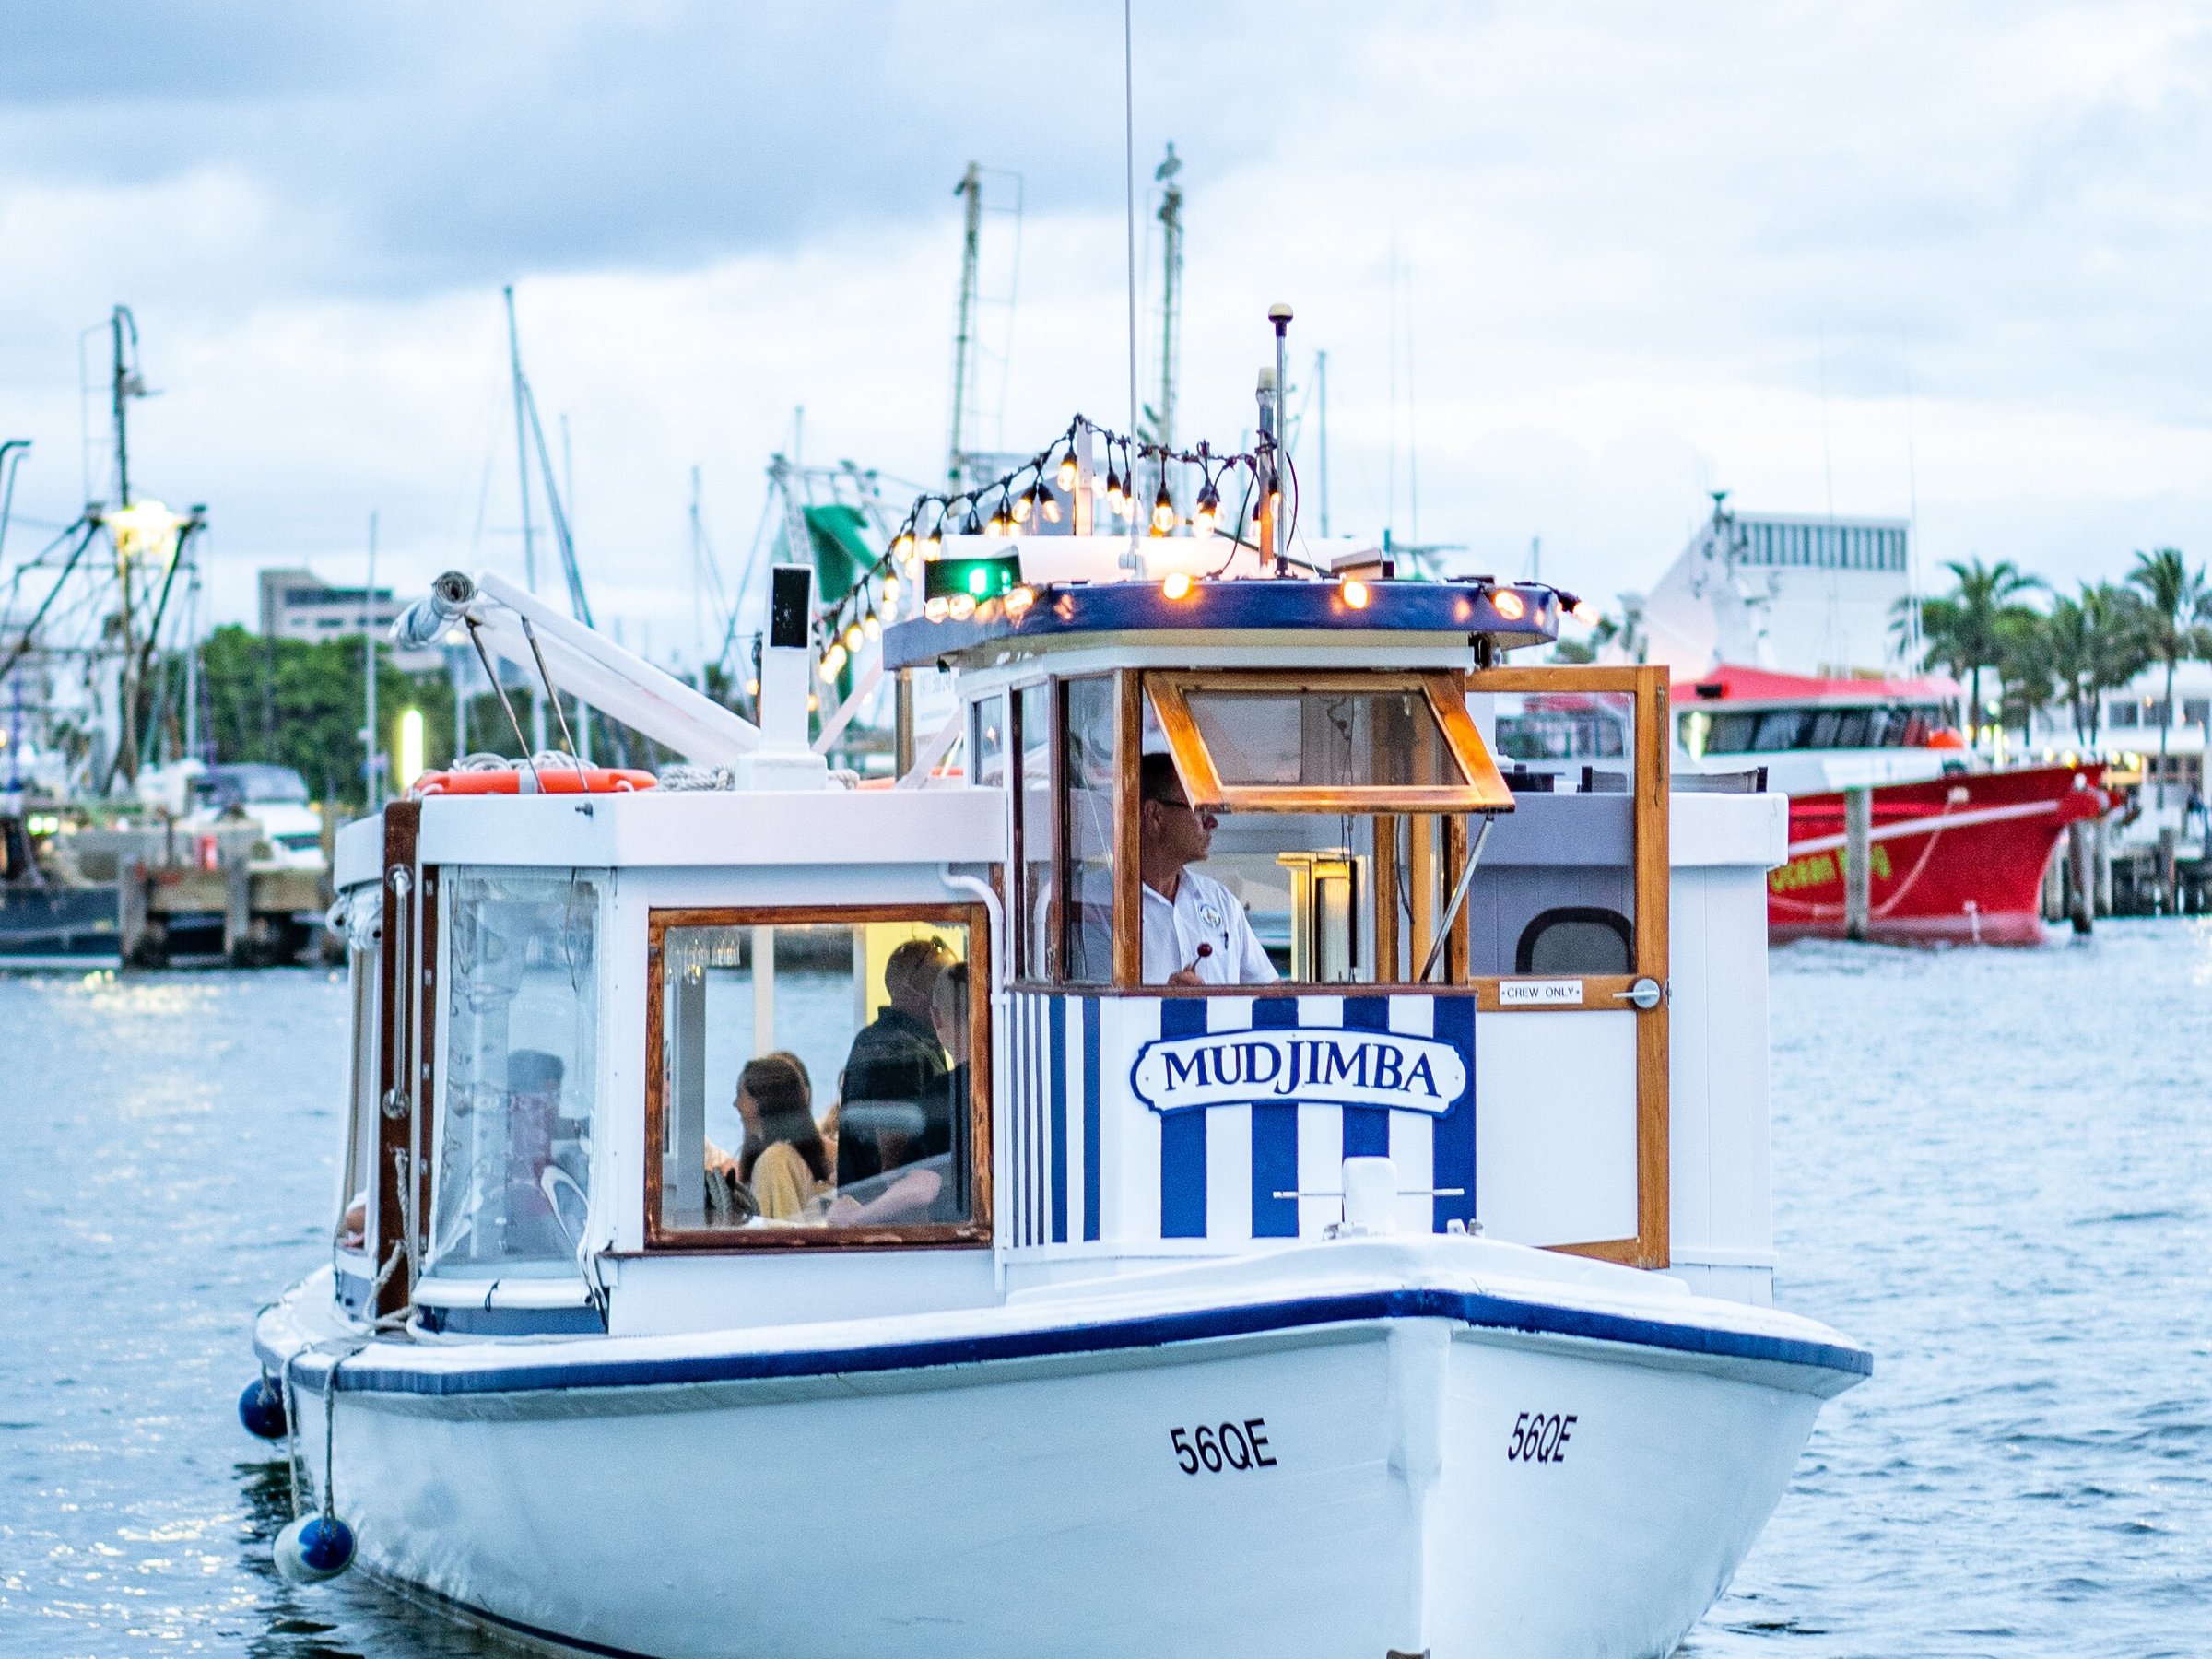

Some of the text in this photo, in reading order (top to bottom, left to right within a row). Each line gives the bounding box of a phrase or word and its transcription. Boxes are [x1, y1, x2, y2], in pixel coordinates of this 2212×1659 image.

[1507, 986, 1574, 998] CREW ONLY
[1160, 1040, 1442, 1099] MUDJIMBA
[1170, 1417, 1278, 1476] 56QE
[1507, 1411, 1578, 1465] 56QE
